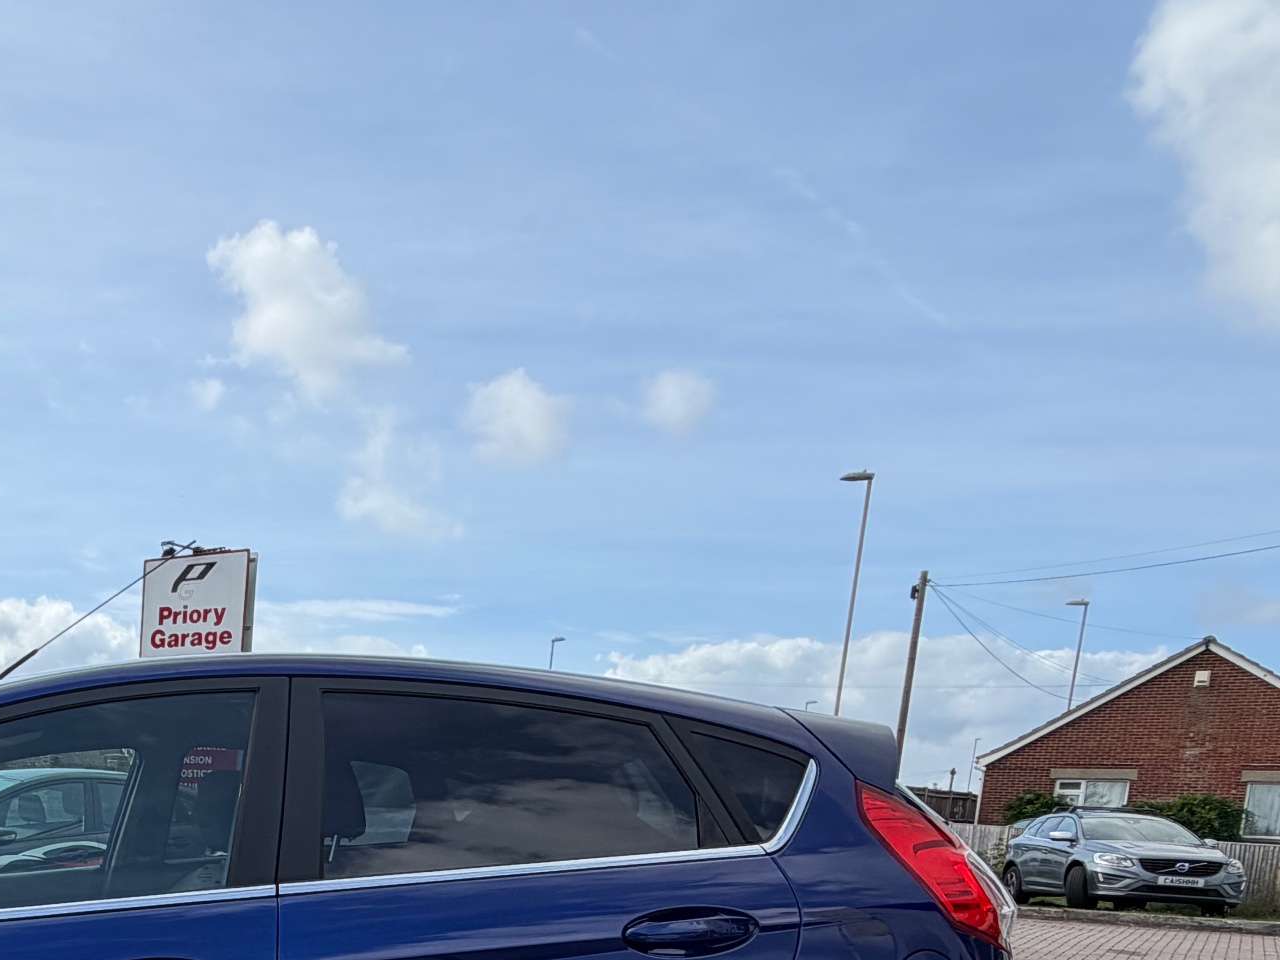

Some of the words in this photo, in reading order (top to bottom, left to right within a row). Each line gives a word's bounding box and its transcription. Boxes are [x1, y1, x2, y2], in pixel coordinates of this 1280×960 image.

[158, 605, 226, 626] Priory
[150, 629, 233, 650] Garage
[180, 769, 214, 778] OSTIC
